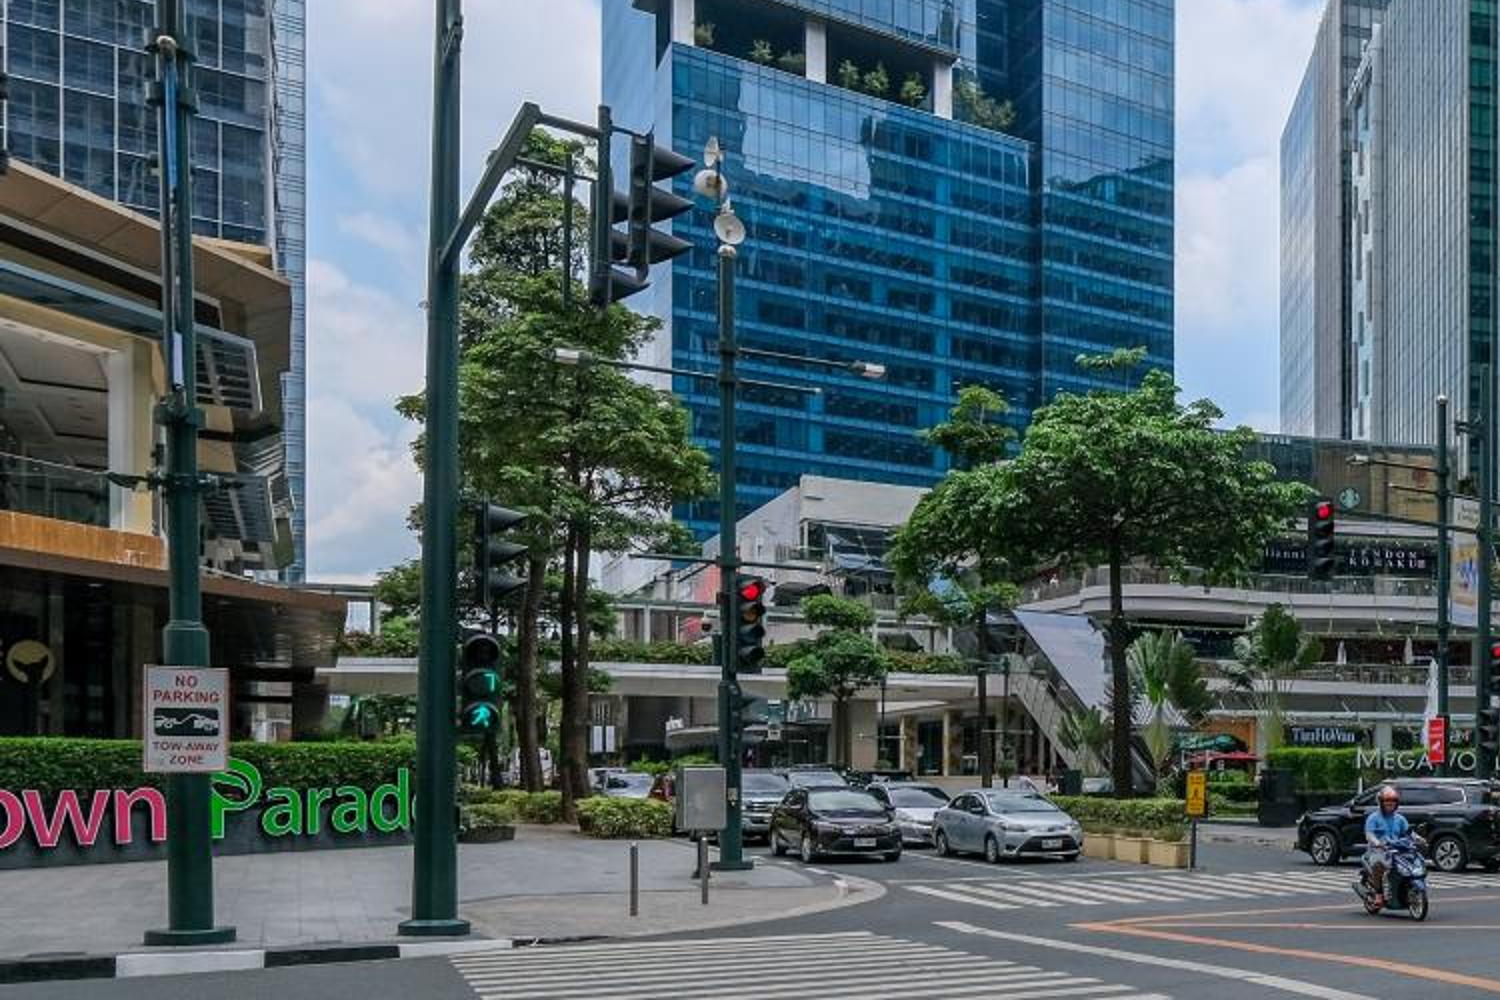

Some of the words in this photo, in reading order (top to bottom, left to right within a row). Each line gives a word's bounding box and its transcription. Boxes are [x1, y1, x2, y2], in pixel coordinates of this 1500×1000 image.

[175, 675, 198, 688] NO
[153, 690, 220, 703] PARKING
[152, 741, 219, 752] TOW-AWAY
[169, 755, 204, 765] ZONE
[212, 758, 416, 839] Parad
